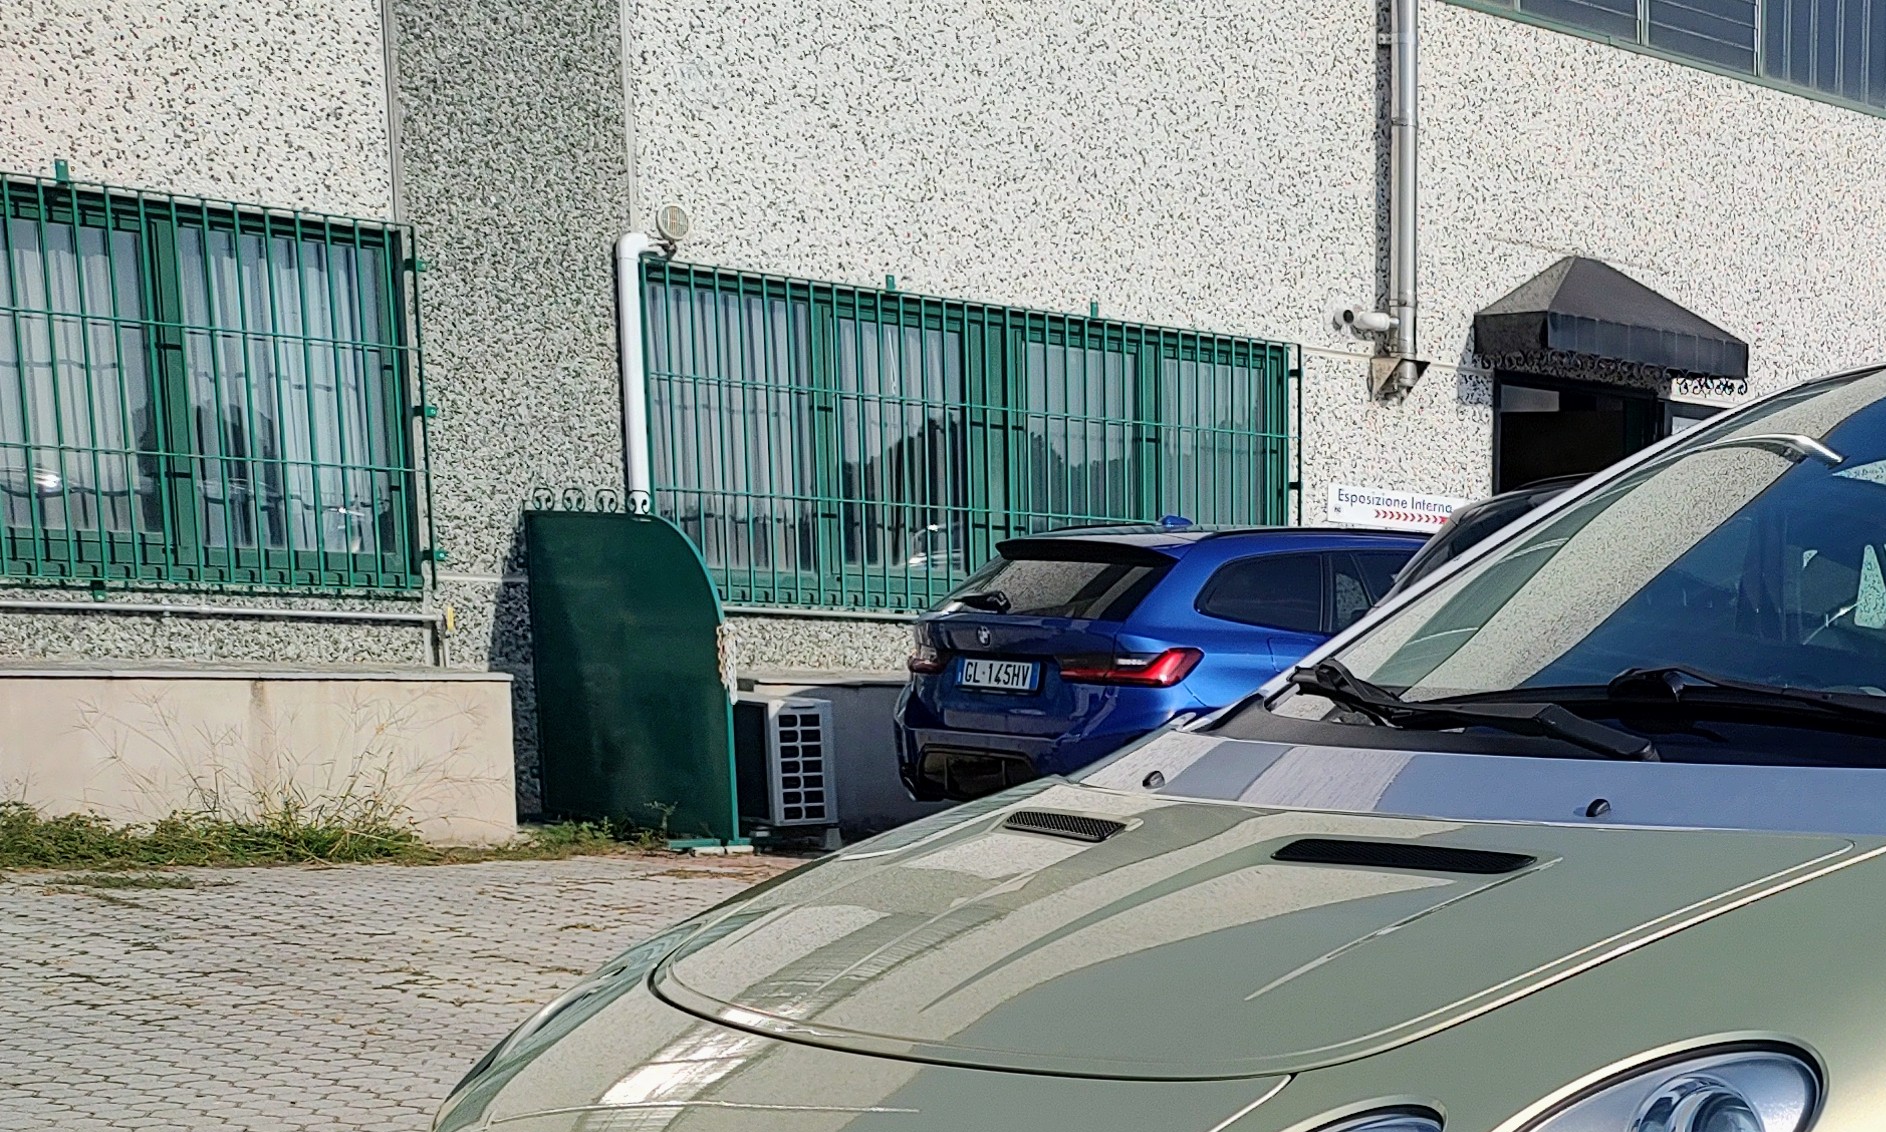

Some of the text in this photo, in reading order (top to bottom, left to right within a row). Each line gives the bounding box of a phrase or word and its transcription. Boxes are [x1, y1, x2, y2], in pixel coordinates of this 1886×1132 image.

[1338, 488, 1408, 509] Esposizione
[965, 662, 1030, 687] GL 145HV
